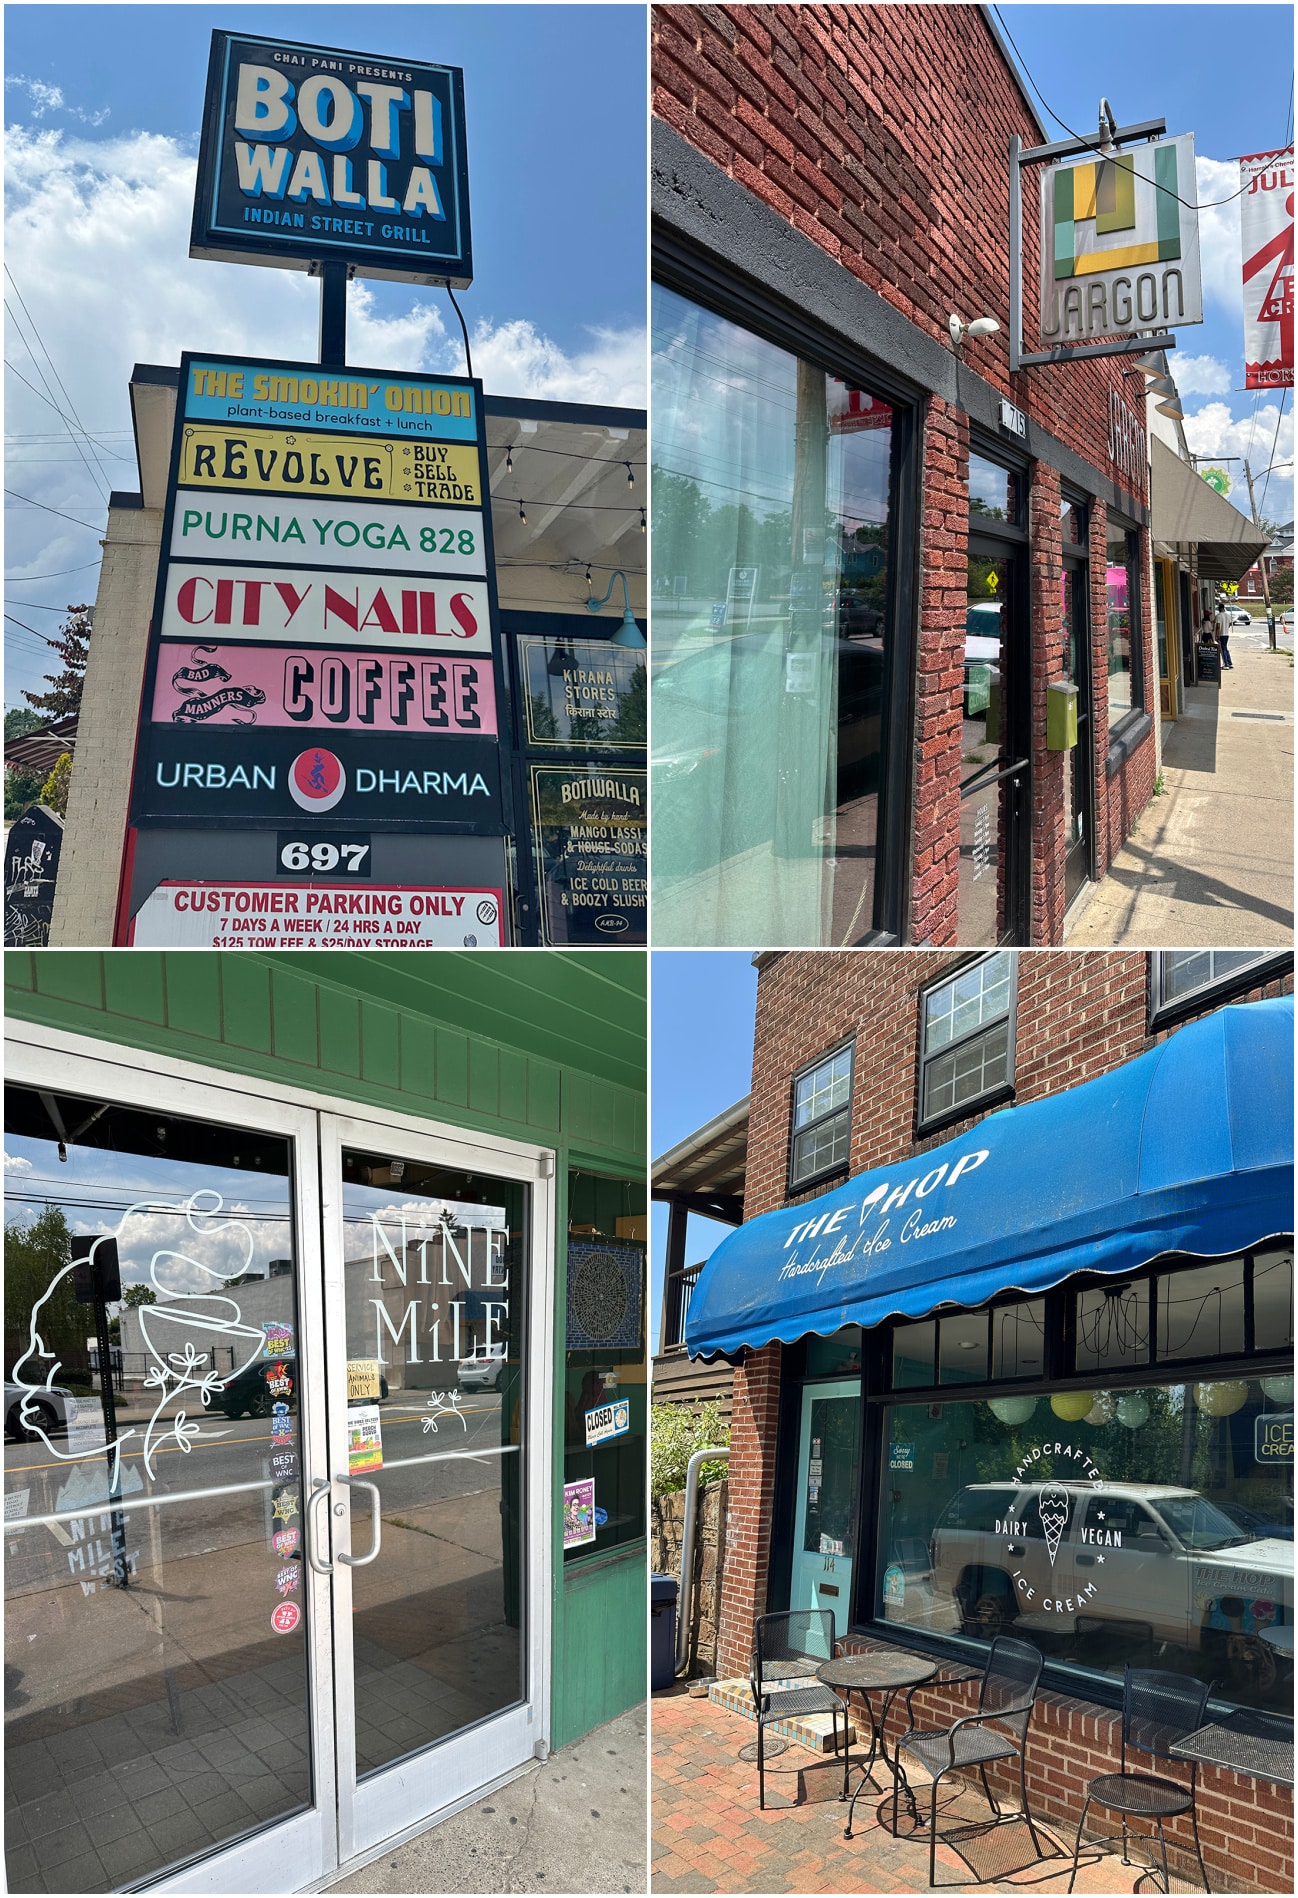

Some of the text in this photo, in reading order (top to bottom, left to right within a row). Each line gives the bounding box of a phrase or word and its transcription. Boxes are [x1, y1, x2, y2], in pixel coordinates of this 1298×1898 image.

[273, 52, 413, 82] CHAI PANI PRESENTS
[234, 63, 444, 167] BOTI
[234, 141, 447, 222] WALLA
[244, 207, 431, 243] INDIAN STREET GRILL
[1042, 267, 1185, 336] JARGON
[192, 369, 472, 418] THE SMOKIN' ONION
[227, 404, 433, 432] plant-based breakfast + lunch
[1010, 407, 1025, 434] 715
[1107, 382, 1145, 488] JARGON
[414, 446, 448, 464] BUY
[414, 464, 457, 482] SELL
[414, 482, 475, 501] TRADE
[182, 510, 476, 556] PURNA YOGA 828
[177, 576, 478, 639] CITY NAILS
[187, 669, 210, 680] BAD
[563, 669, 614, 685] KIRANA
[282, 655, 481, 729] COFFEE
[565, 685, 615, 701] STORES
[185, 691, 243, 714] MANNERS
[156, 762, 491, 797] URBAN DHARMA
[561, 779, 641, 807] BOTIWALLA
[578, 810, 599, 820] Made
[570, 826, 641, 840] MANGO LASSI
[567, 840, 647, 855] & HOUSE SODAS
[280, 842, 370, 872] 697
[577, 860, 638, 874] Delightful drinks
[570, 877, 647, 892] ICE COLD BEER
[174, 891, 299, 914] CUSTOMER
[306, 892, 402, 916] PARKING
[409, 895, 466, 917] ONLY
[561, 892, 569, 906] &
[572, 893, 609, 906] BOOZY
[220, 918, 422, 934] 7 DAYS A WEEK / 24 HRS A DAY
[212, 936, 433, 947] $125 TOW FEE & $25/DAY STORAGE
[783, 1149, 990, 1249] THE HOP
[778, 1208, 958, 1287] Handcrafted Ice Cream
[267, 1339, 290, 1349] BEST
[270, 1378, 290, 1389] BEST
[348, 1373, 375, 1383] ANIMALS
[350, 1384, 371, 1397] ONLY
[272, 1416, 291, 1424] BEST
[587, 1408, 612, 1432] CLOSED
[1265, 1423, 1294, 1443] ICE
[893, 1445, 911, 1457] Sorry
[273, 1455, 295, 1466] BEST
[890, 1460, 913, 1469] CLOSED
[1010, 1442, 1104, 1492] HANDCRAFTED
[276, 1469, 293, 1477] WNC
[564, 1490, 575, 1498] KIM
[576, 1485, 592, 1495] RONEY
[277, 1508, 294, 1516] WNC
[70, 1510, 130, 1543] NINE
[995, 1519, 1028, 1537] DAIRY
[276, 1531, 296, 1544] BEST
[1081, 1527, 1122, 1548] VEGAN
[68, 1530, 126, 1574] MILE
[277, 1569, 289, 1578] BEST
[823, 1556, 835, 1573] 114
[278, 1570, 298, 1585] WNC
[1195, 1567, 1275, 1586] THE HOP
[1013, 1570, 1099, 1613] ICE CREAM
[1213, 1582, 1247, 1592] Cream
